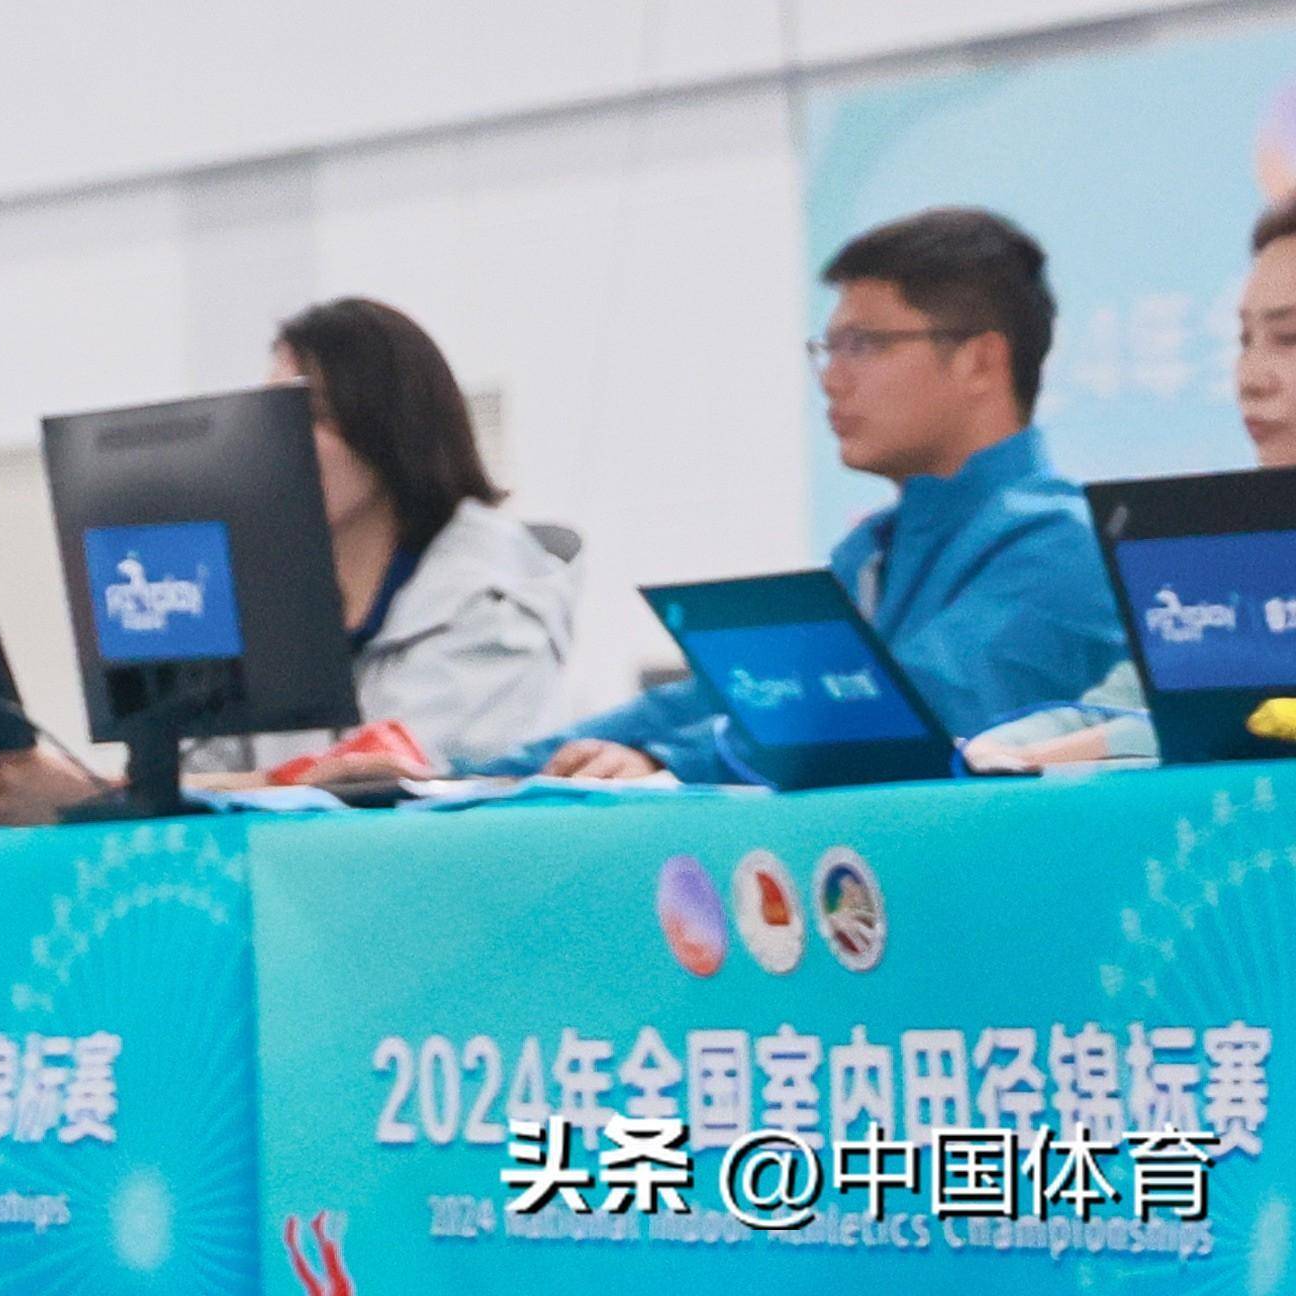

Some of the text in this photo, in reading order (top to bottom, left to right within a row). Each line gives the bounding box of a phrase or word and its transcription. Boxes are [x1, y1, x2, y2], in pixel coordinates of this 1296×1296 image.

[371, 1020, 1272, 1158] 2024年全国室内田径锦标赛
